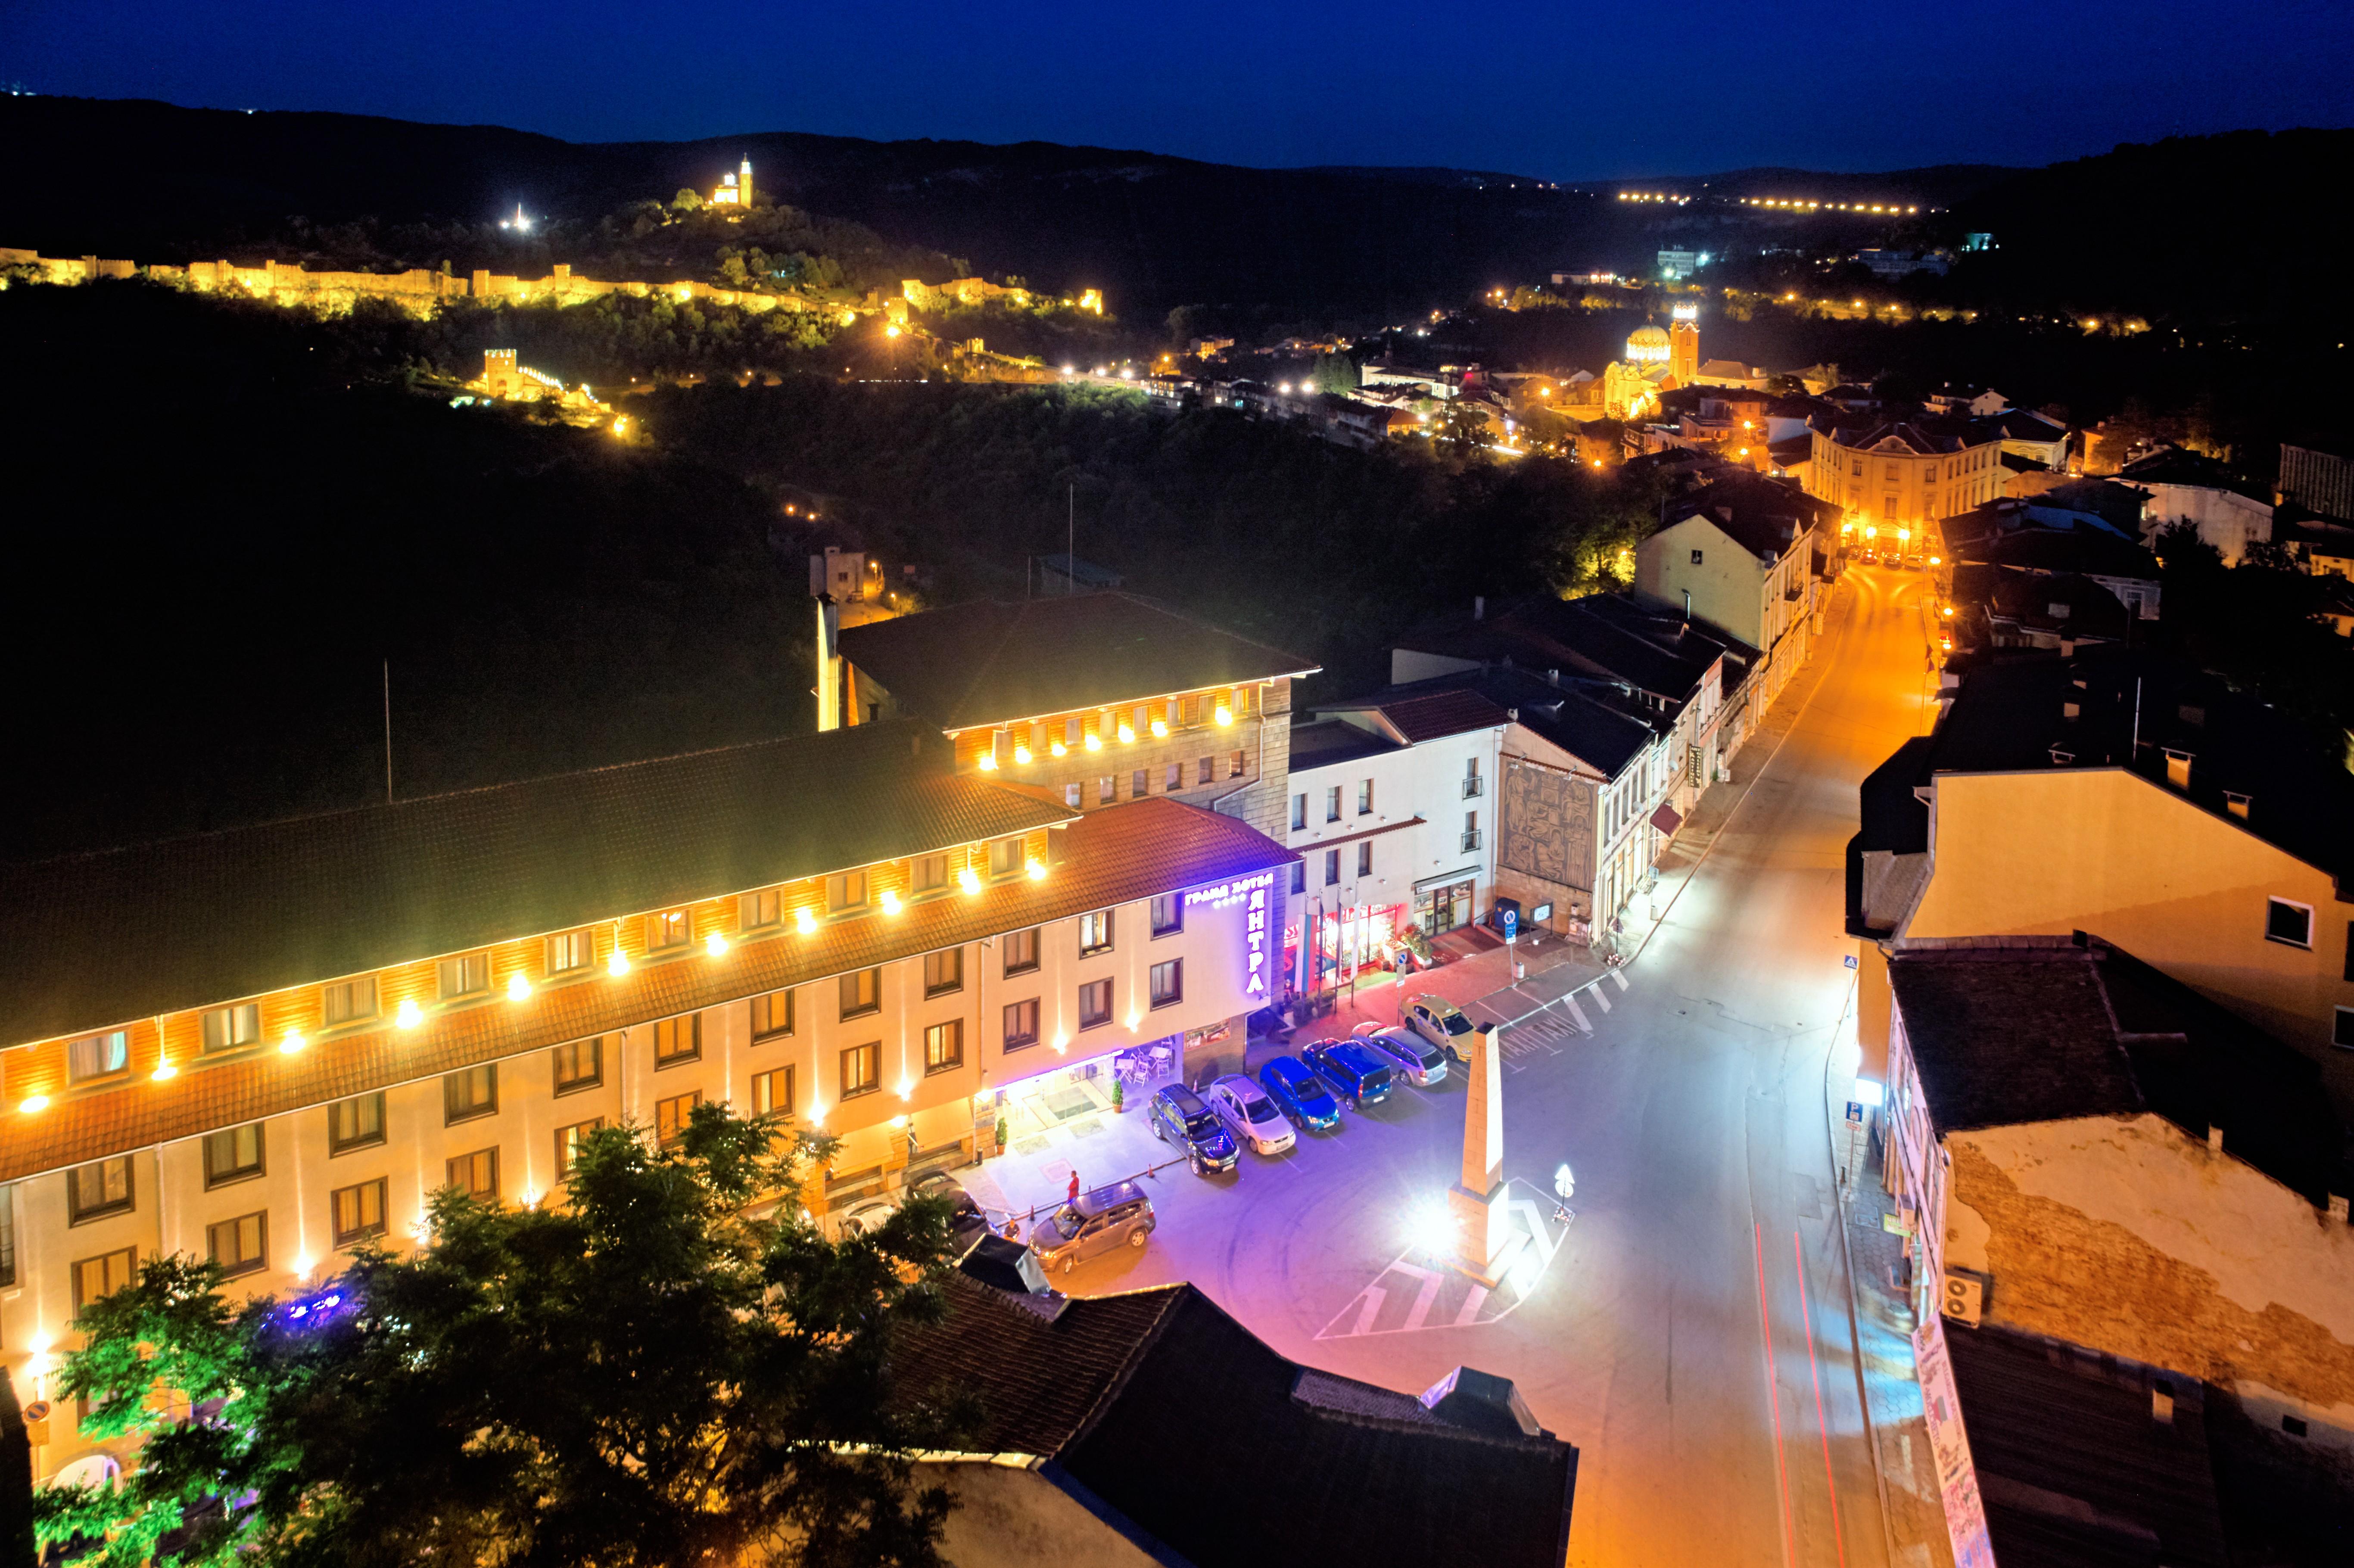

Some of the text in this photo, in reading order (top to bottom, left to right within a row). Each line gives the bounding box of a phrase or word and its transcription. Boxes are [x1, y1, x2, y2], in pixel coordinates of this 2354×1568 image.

[1246, 889, 1265, 993] ЯНТРА
[1525, 1017, 1577, 1042] TAXI
[1851, 1103, 1859, 1111] P
